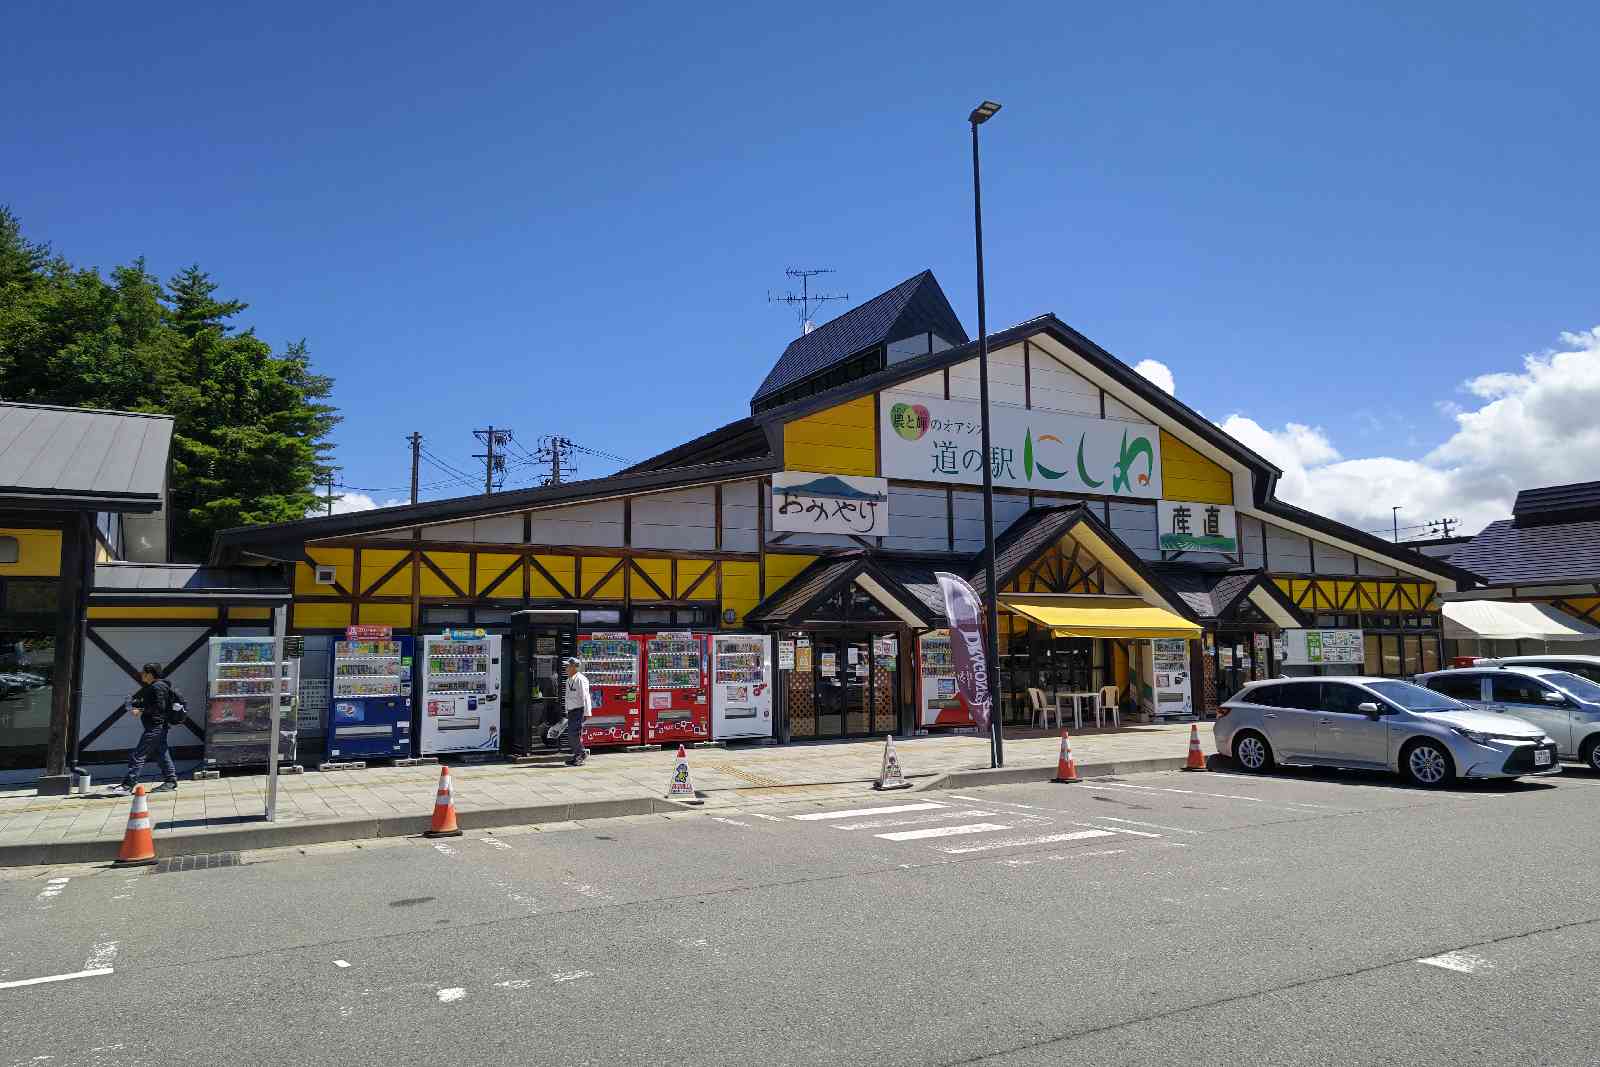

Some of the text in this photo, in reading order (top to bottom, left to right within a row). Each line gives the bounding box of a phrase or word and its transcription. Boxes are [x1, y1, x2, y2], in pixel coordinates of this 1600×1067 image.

[931, 440, 1017, 480] 道の駅
[779, 491, 882, 533] おみやげ
[1173, 505, 1224, 538] 産直
